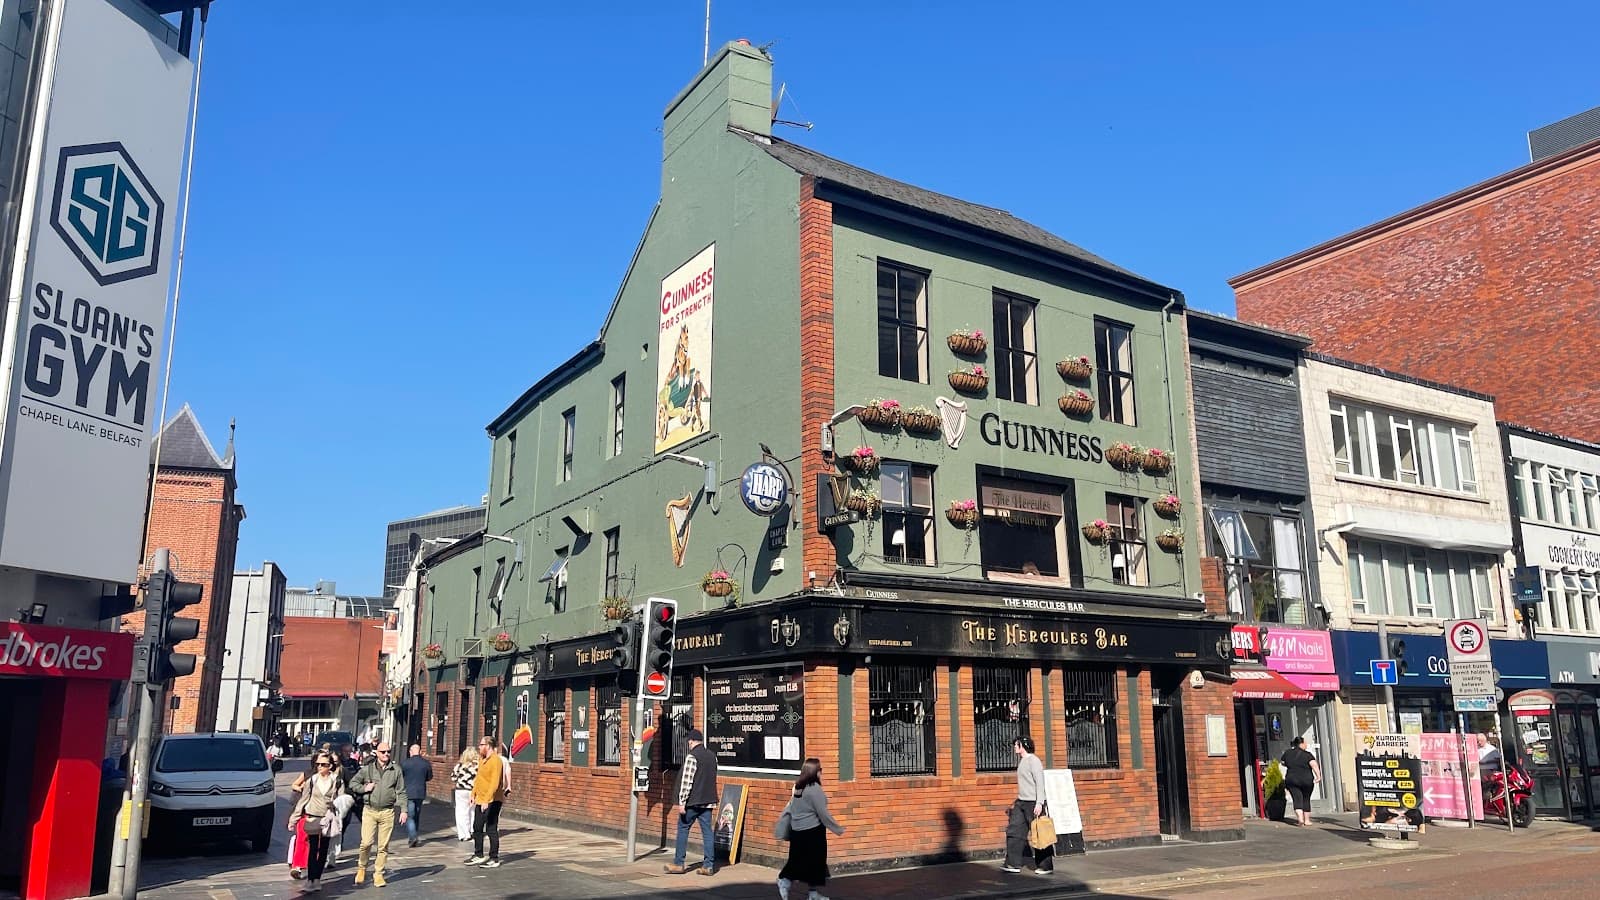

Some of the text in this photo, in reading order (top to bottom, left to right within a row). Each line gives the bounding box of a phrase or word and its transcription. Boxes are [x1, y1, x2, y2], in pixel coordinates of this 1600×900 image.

[67, 163, 150, 264] SG
[662, 267, 713, 315] GUINNESS
[33, 282, 154, 358] SLOAN'S
[661, 292, 712, 333] FOR STRENGTH
[24, 323, 150, 426] GYM
[19, 405, 143, 449] CHAPEL LANE, BELFAST
[980, 412, 1103, 463] GUINNESS
[752, 473, 783, 500] HARP
[825, 512, 849, 526] GUINNESS
[1548, 545, 1600, 569] COOKERY SCH
[865, 589, 898, 599] GUINNESS
[1003, 598, 1085, 612] THE HERCULES BAR
[961, 620, 1128, 650] THE HERCULES BAR
[1270, 636, 1324, 657] A&M Nails
[576, 648, 590, 666] THE
[1558, 671, 1575, 684] ATM
